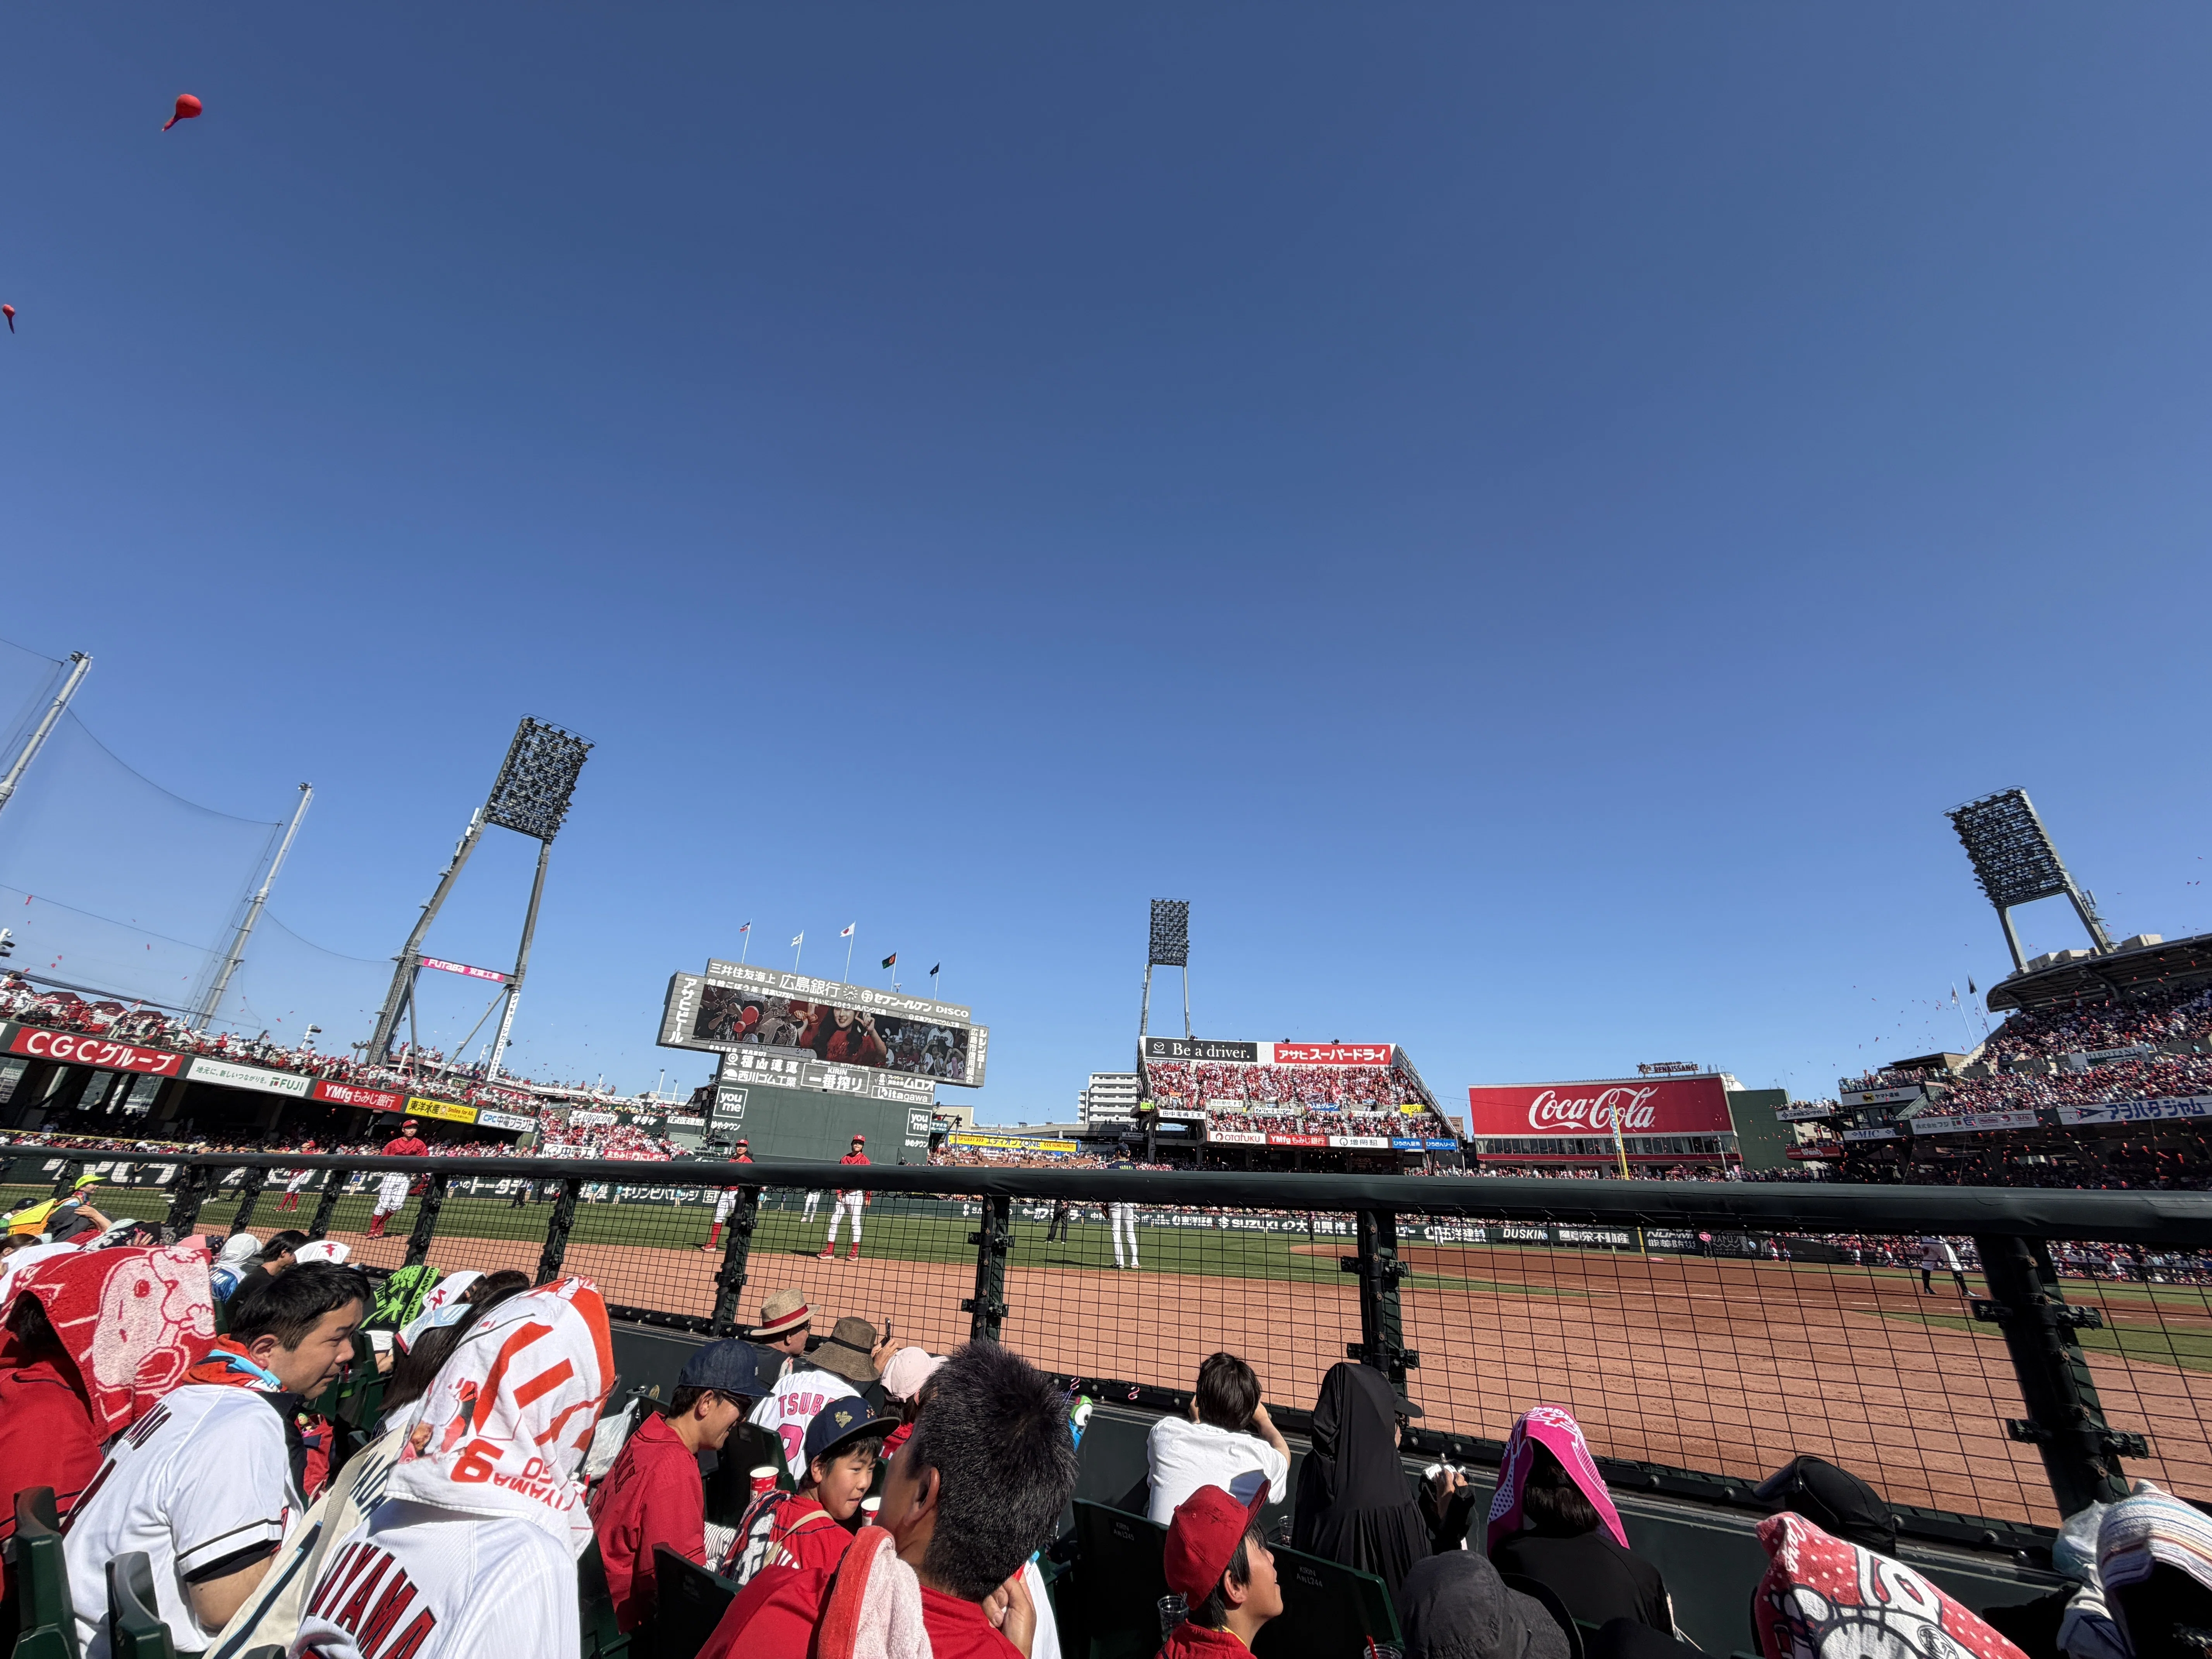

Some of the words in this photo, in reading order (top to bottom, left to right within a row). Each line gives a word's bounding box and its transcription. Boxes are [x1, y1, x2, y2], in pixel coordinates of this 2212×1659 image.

[709, 963, 776, 984] 三井住友海上
[779, 974, 840, 998] 広島銀行
[668, 977, 697, 1043] アサヒビール
[936, 1006, 969, 1017] DISCO
[27, 1031, 176, 1073] CGCグループ
[1173, 1043, 1191, 1057] Be
[1196, 1048, 1203, 1057] a
[1207, 1044, 1250, 1059] driver.
[1279, 1048, 1386, 1061] アサヒスーパードライ
[2085, 1048, 2136, 1060] HIROTANI
[740, 1055, 799, 1074] 福山通運
[1654, 1064, 1699, 1073] RENAISSANCE
[828, 1067, 848, 1075] KIRIN
[196, 1066, 267, 1084] 地元に、新しいつながりを。
[279, 1079, 304, 1091] FUJI
[737, 1070, 797, 1088] 西川ゴム工業
[809, 1074, 862, 1091] 一番搾り
[903, 1077, 936, 1091] ムロオ
[325, 1084, 352, 1103] YMfg
[353, 1090, 395, 1108] もみじ銀行
[720, 1092, 742, 1103] you
[411, 1101, 440, 1115] 東洋水産
[722, 1103, 741, 1112] me
[1528, 1087, 1659, 1130] Coca-Cola
[483, 1114, 497, 1123] CPC
[497, 1115, 534, 1131] 中電プラント
[582, 1114, 614, 1123] LOGICOM
[632, 1115, 657, 1125] サタケ
[911, 1113, 928, 1123] you
[711, 1121, 740, 1131] ゆめタウン
[913, 1122, 928, 1131] me
[1270, 1135, 1291, 1145] YMfg
[1291, 1137, 1325, 1145] もみじ銀行
[1858, 1130, 1879, 1138] MIC
[1019, 1139, 1041, 1148] ZONE
[1231, 1219, 1279, 1230] SUZUKI
[1503, 1228, 1547, 1240] DUSKIN
[1647, 1239, 1696, 1250] 能美防災
[778, 1392, 836, 1419] TSUB
